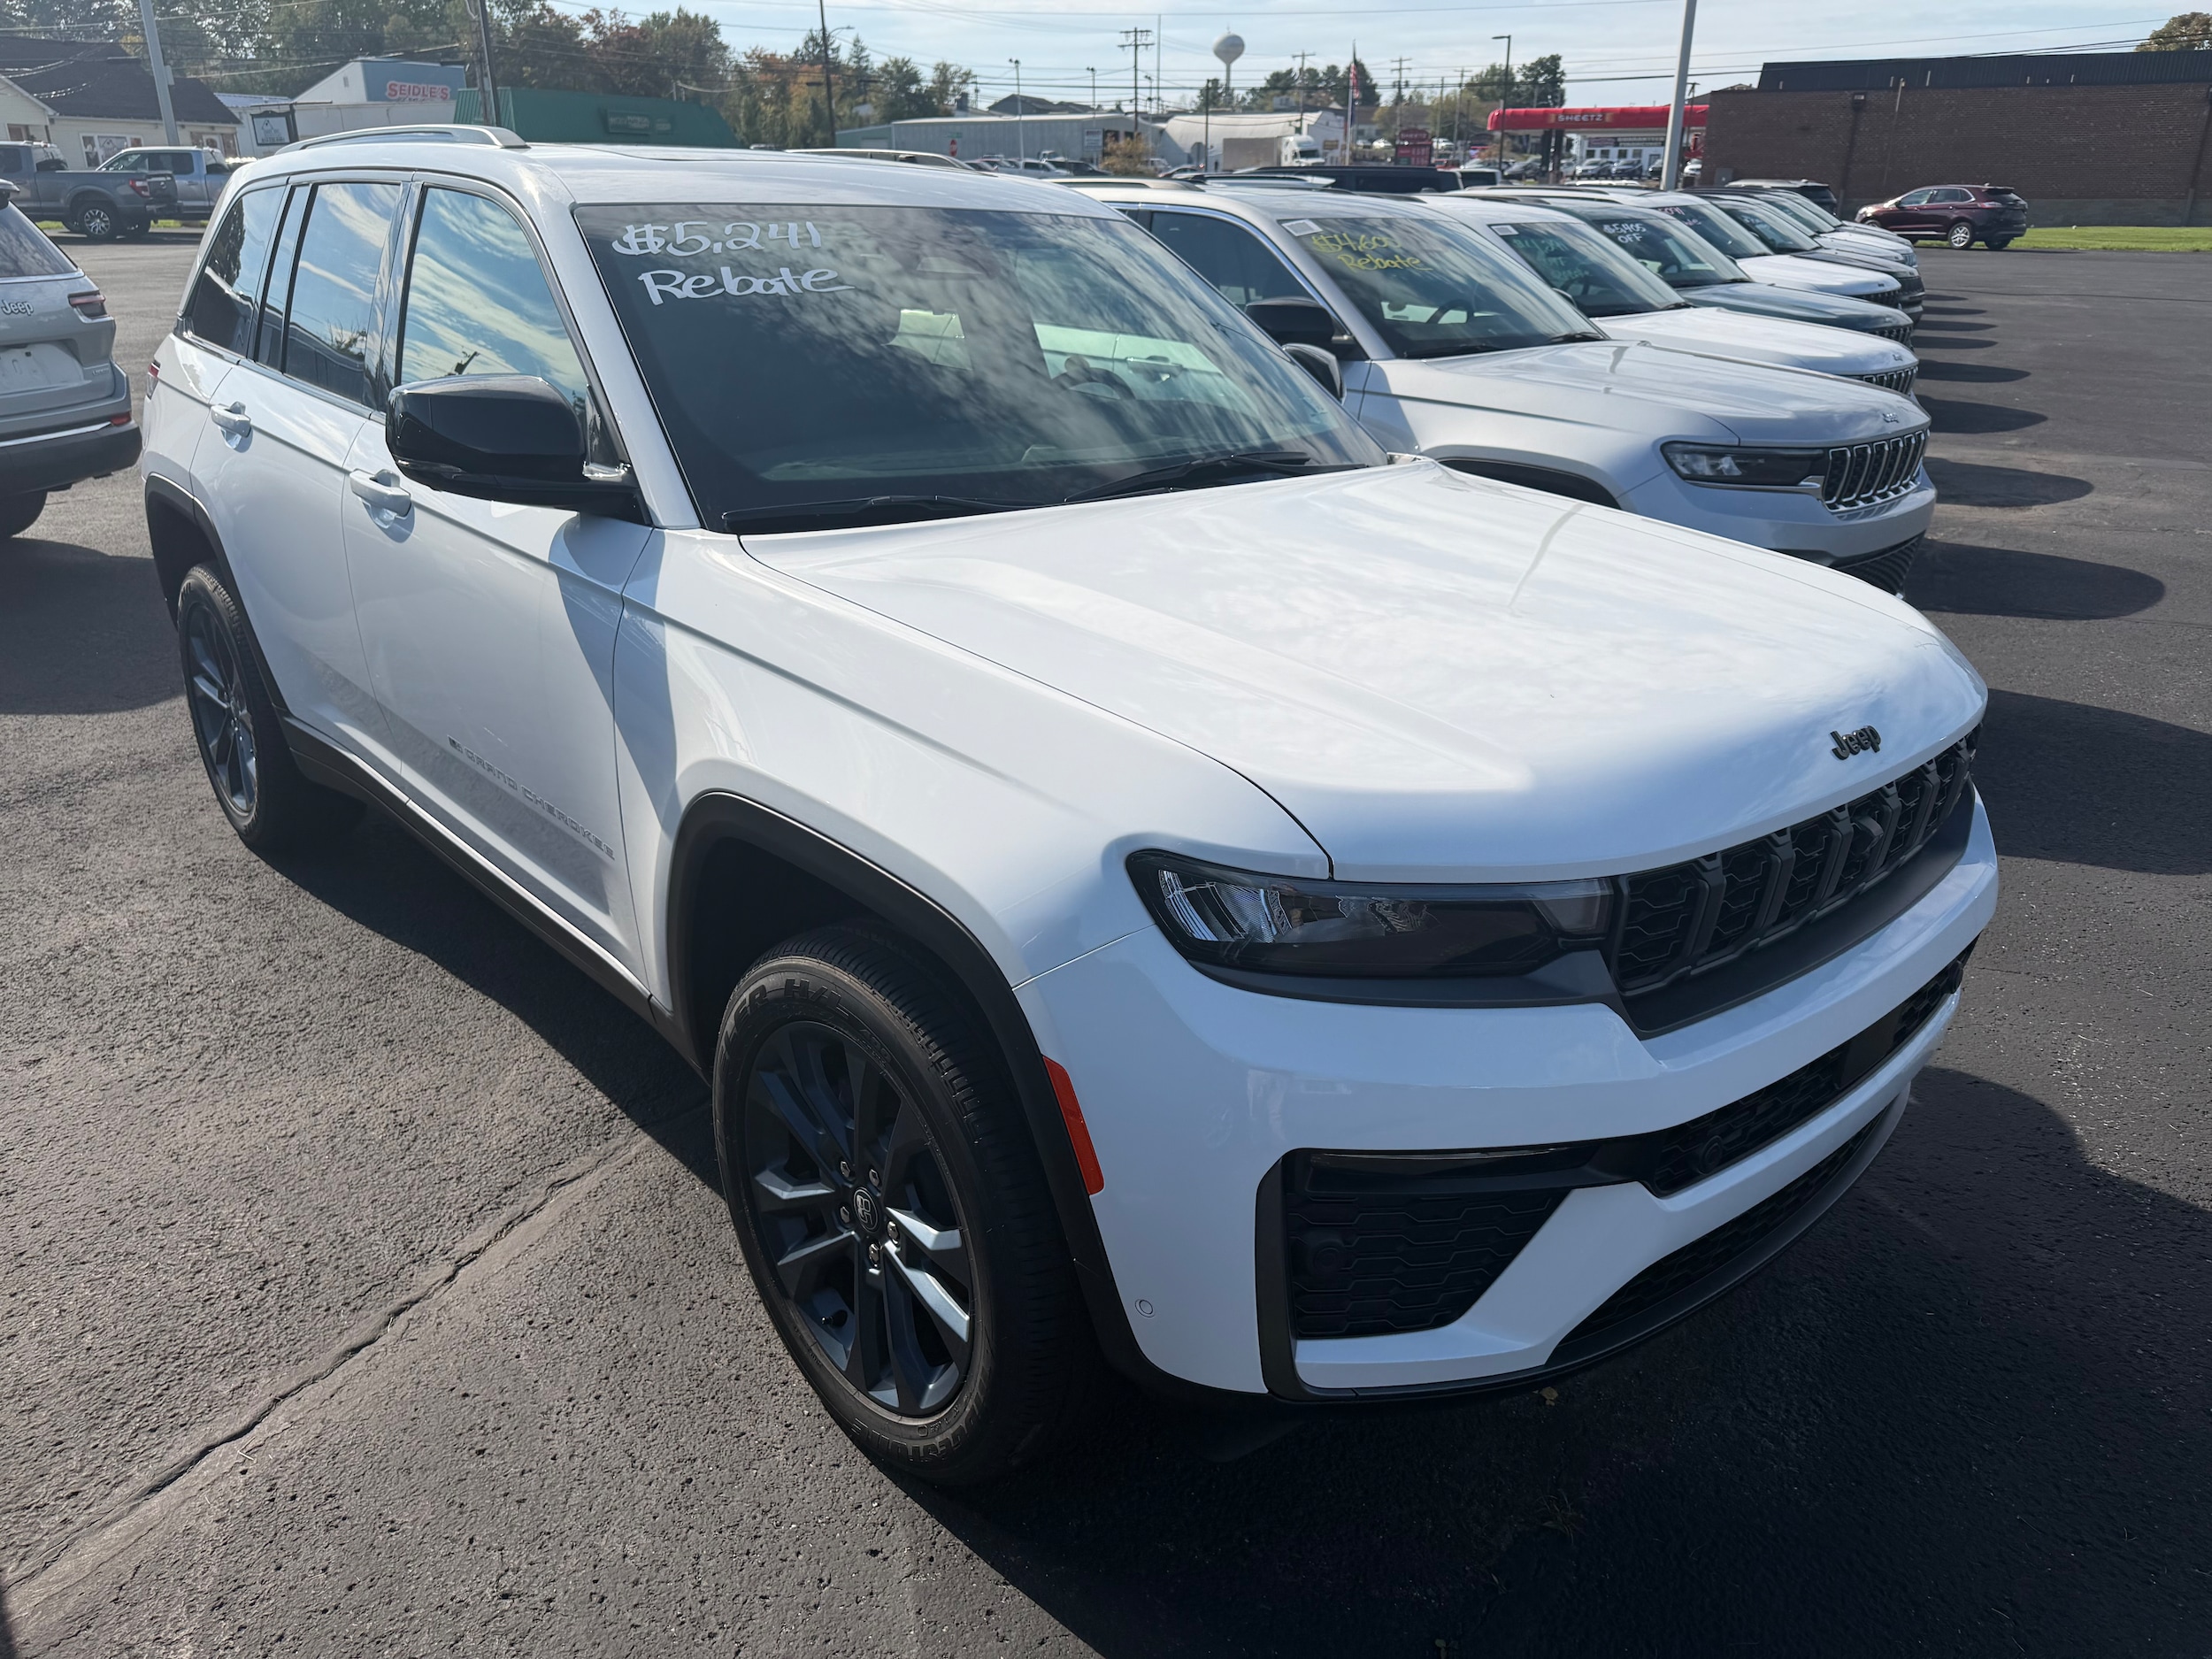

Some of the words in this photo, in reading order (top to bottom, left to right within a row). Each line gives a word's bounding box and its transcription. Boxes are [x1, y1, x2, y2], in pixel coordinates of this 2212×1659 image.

[387, 81, 450, 100] SEIDLE'S
[1617, 234, 1643, 243] OFF
[1337, 254, 1433, 273] Rebate
[638, 266, 856, 306] Rebate
[1, 299, 35, 316] Jeep
[1830, 725, 1881, 761] Jeep
[464, 746, 518, 791] GRAND
[520, 784, 616, 861] CHEROKEE
